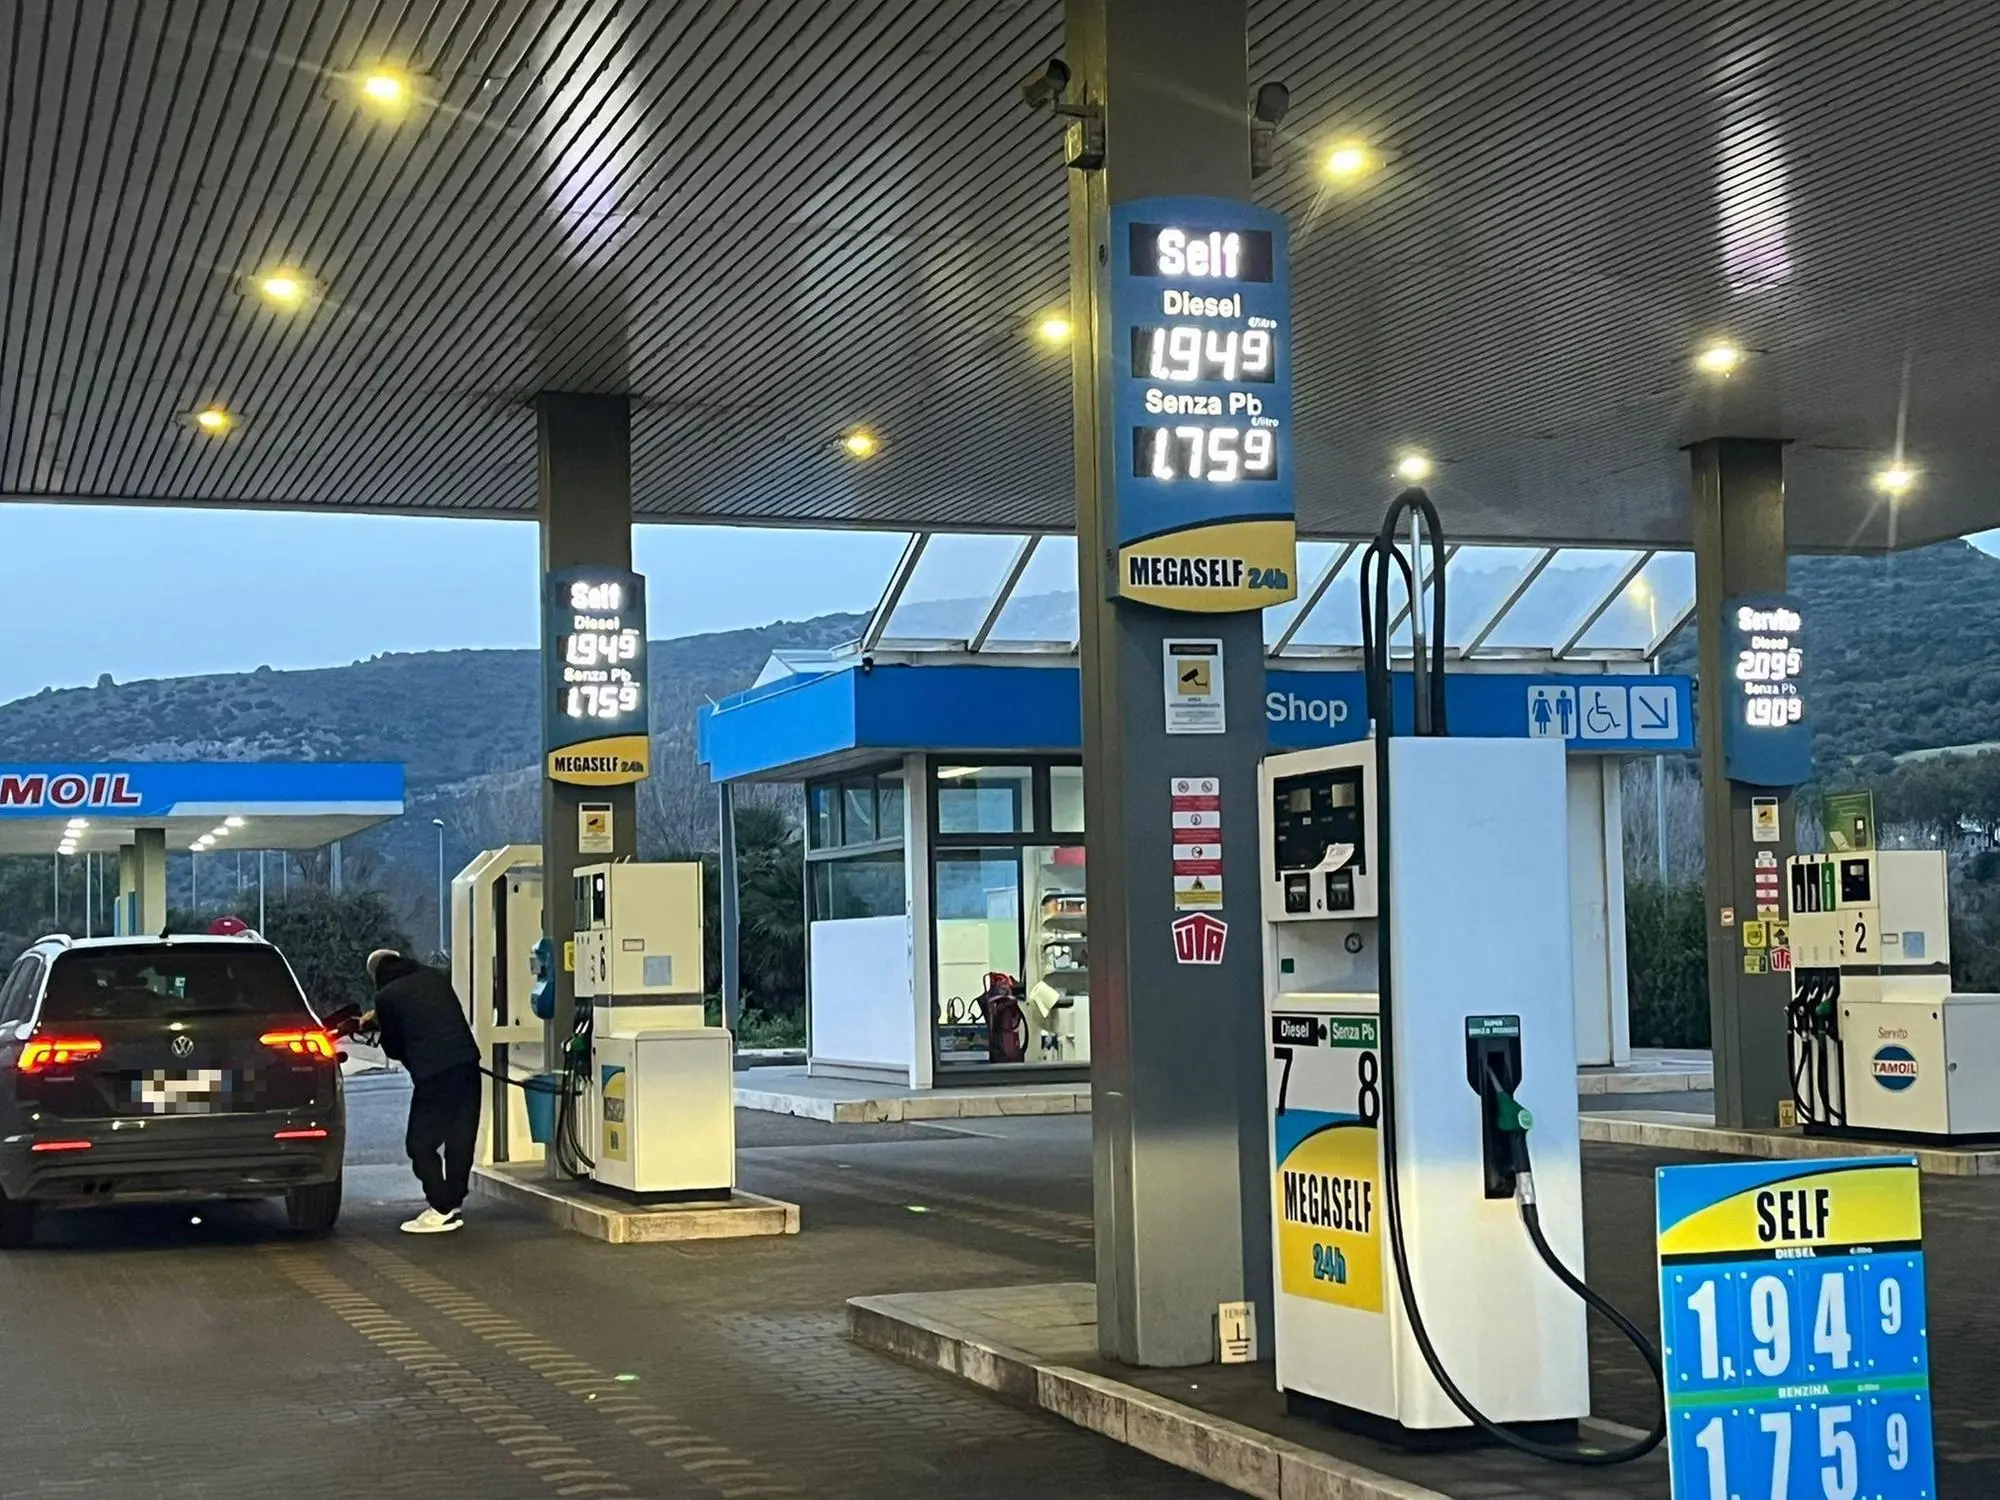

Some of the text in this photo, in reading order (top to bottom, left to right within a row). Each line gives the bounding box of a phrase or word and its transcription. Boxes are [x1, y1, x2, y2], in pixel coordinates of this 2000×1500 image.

[1157, 229, 1241, 277] Self
[1163, 291, 1241, 318] Diesel
[1145, 389, 1262, 416] Senza Pb
[1130, 557, 1288, 590] MEGASELF 24h
[574, 615, 619, 631] Diesel
[611, 668, 631, 682] Pb
[1781, 683, 1797, 695] Pb
[1265, 692, 1348, 727] Shop
[554, 757, 618, 772] MEGASELF
[1173, 914, 1227, 963] UTA
[1854, 922, 1867, 953] 2
[1280, 1020, 1310, 1038] Diesel
[1332, 1021, 1375, 1042] Senza Pb
[1274, 1047, 1294, 1116] 7
[1872, 1062, 1918, 1074] TAMOIL
[1358, 1051, 1381, 1126] 8
[1284, 1171, 1372, 1234] MEGASELF
[1757, 1189, 1829, 1242] SELF
[1312, 1243, 1347, 1284] 24h
[1775, 1247, 1817, 1260] DIESEL
[1778, 1384, 1830, 1399] BENZINA
